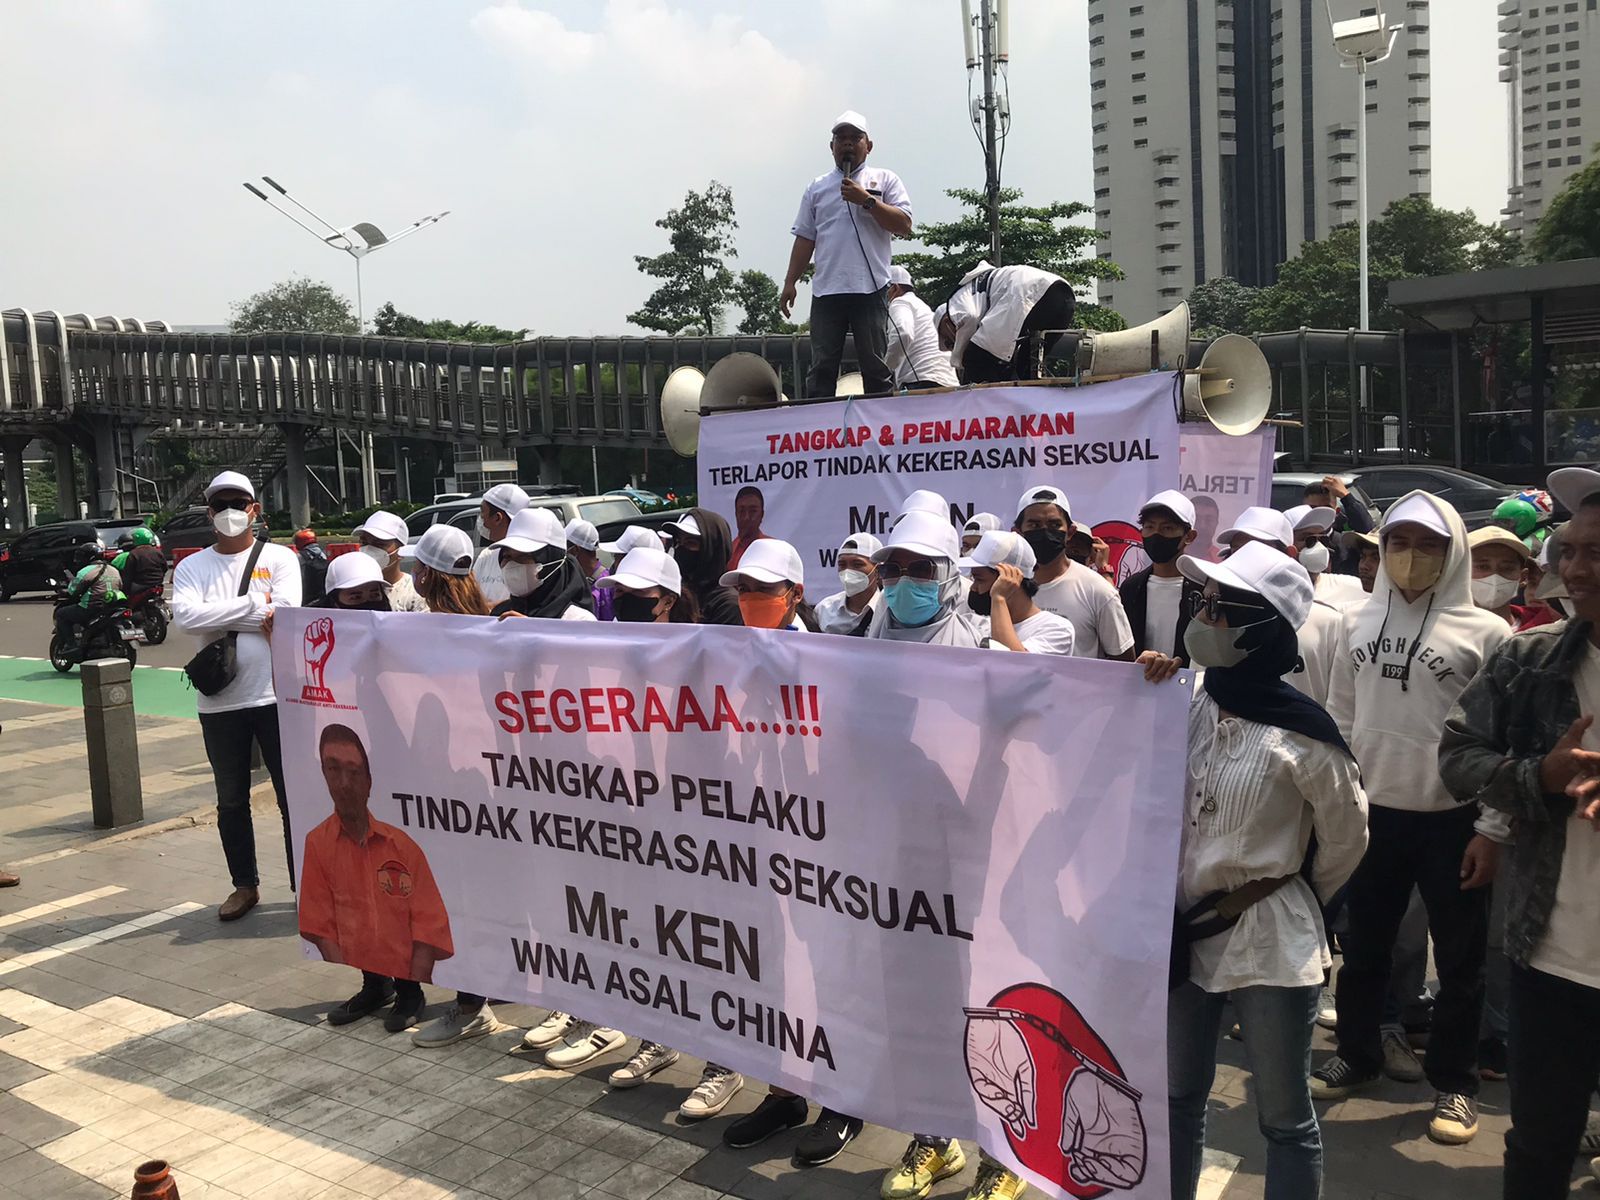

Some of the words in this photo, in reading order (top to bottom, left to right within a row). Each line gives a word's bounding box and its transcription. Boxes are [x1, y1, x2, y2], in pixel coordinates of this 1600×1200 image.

[709, 459, 808, 486] TERLAPOR
[814, 453, 892, 477] TINDAK
[896, 446, 1036, 473] KEKERASAN
[1043, 438, 1159, 467] SEKSUAL
[766, 424, 871, 455] TANGKAP
[878, 424, 895, 447] &
[902, 411, 1075, 445] PENJARAKAN
[306, 688, 329, 699] AMAK
[1384, 665, 1407, 678] 199
[481, 752, 659, 807] TANGKAP
[671, 774, 826, 841] PELAKU
[392, 793, 522, 843] TINDAK
[529, 810, 757, 887] KEKERASAN
[769, 853, 974, 941] SEKSUAL
[565, 885, 640, 949] Mr.
[655, 904, 760, 982] KEN
[510, 937, 596, 990] WNA
[604, 961, 700, 1021] ASAL
[711, 990, 837, 1071] CHINA
